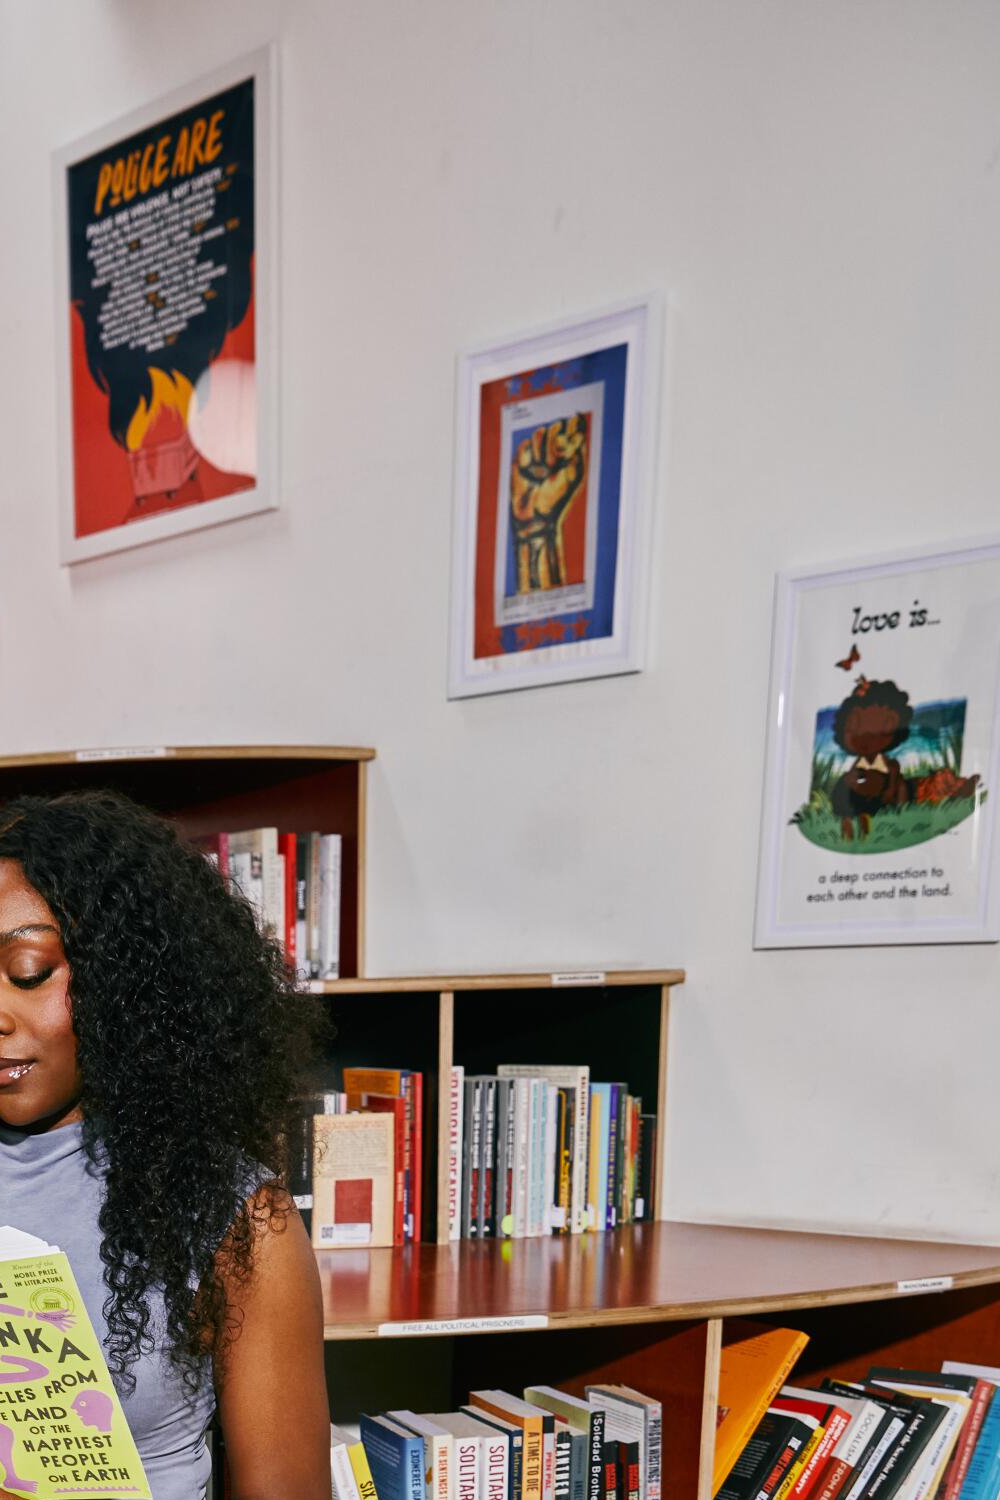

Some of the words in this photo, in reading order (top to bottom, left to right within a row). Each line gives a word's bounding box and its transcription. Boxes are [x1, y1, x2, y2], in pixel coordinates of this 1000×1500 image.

[94, 134, 171, 215] POLICE
[172, 110, 224, 177] ARE
[852, 607, 901, 634] love
[819, 874, 825, 884] a
[830, 870, 859, 888] deep
[864, 867, 927, 882] connection
[932, 867, 943, 878] to
[807, 889, 834, 903] each
[838, 886, 869, 902] other
[873, 886, 896, 899] and
[899, 886, 917, 898] the
[24, 1277, 63, 1286] LITERATURE
[441, 1321, 479, 1330] POLITICAL
[481, 1319, 525, 1328] PRISONERS
[45, 1369, 98, 1399] FROM
[12, 1406, 67, 1422] LAND
[29, 1426, 46, 1435] OF
[50, 1425, 71, 1434] THE
[845, 1411, 874, 1462] SOCIALISM
[23, 1435, 112, 1451] HAPPIEST
[592, 1418, 602, 1462] Soledad
[528, 1440, 539, 1461] TIME
[40, 1453, 109, 1468] PEOPLE
[411, 1450, 421, 1487] EXONEREE
[49, 1474, 68, 1483] ON
[74, 1468, 129, 1481] EARTH
[527, 1464, 539, 1476] TO
[833, 1461, 848, 1493] FROM
[360, 1481, 375, 1497] SIX
[527, 1478, 539, 1491] DIE
